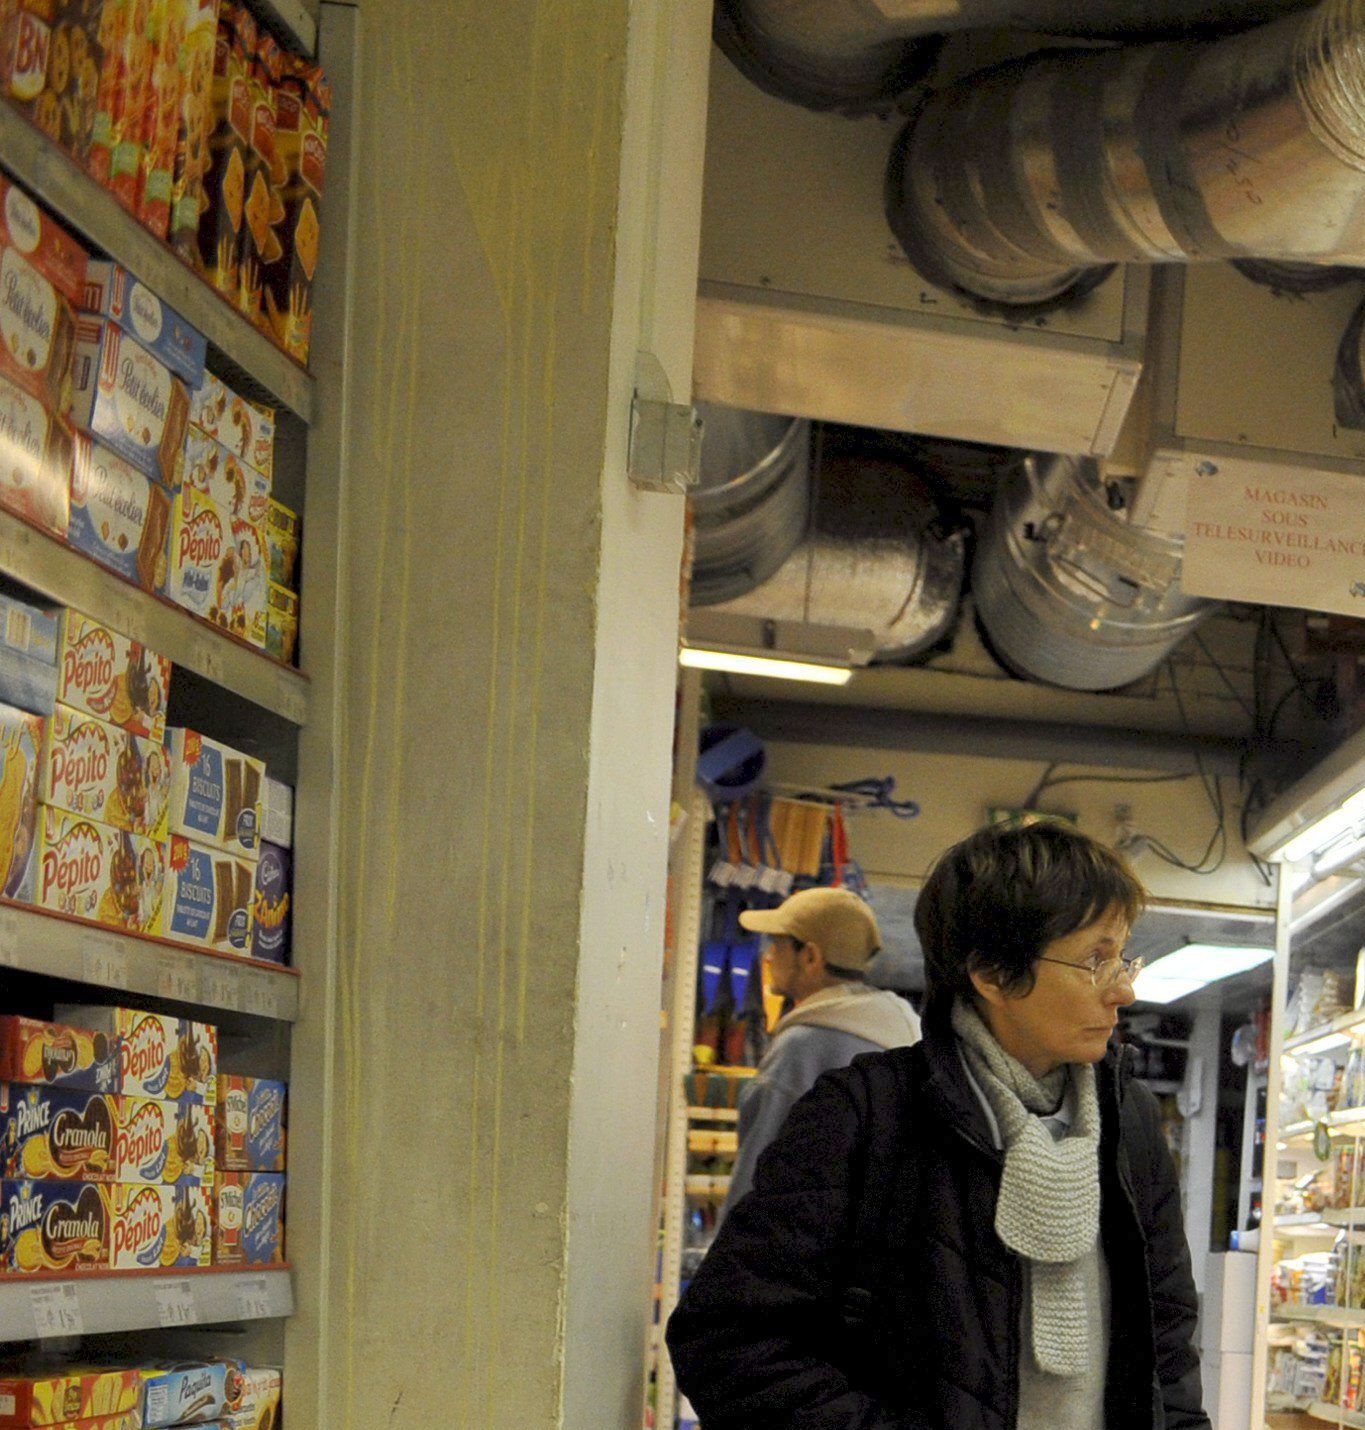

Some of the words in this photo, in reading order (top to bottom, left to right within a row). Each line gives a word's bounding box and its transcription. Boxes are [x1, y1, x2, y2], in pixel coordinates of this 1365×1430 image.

[1243, 486, 1329, 511] MAGASIN
[1261, 509, 1308, 529] SOUS
[179, 527, 221, 569] Pépito
[1253, 549, 1312, 569] VIDEO
[64, 650, 112, 698] Pépito
[51, 745, 107, 798] Pépito
[192, 776, 221, 802] BISCUITS
[42, 848, 101, 903] Pépito
[180, 882, 212, 905] BISCUITS
[120, 1037, 164, 1087] Pépito
[17, 1100, 50, 1138] PRINCE
[54, 1113, 107, 1149] Granola
[117, 1124, 162, 1178] Pépito
[10, 1193, 43, 1233] PRINCE
[46, 1205, 100, 1239] Granola
[113, 1208, 160, 1268] Pépito
[179, 1370, 212, 1403] Paquita
